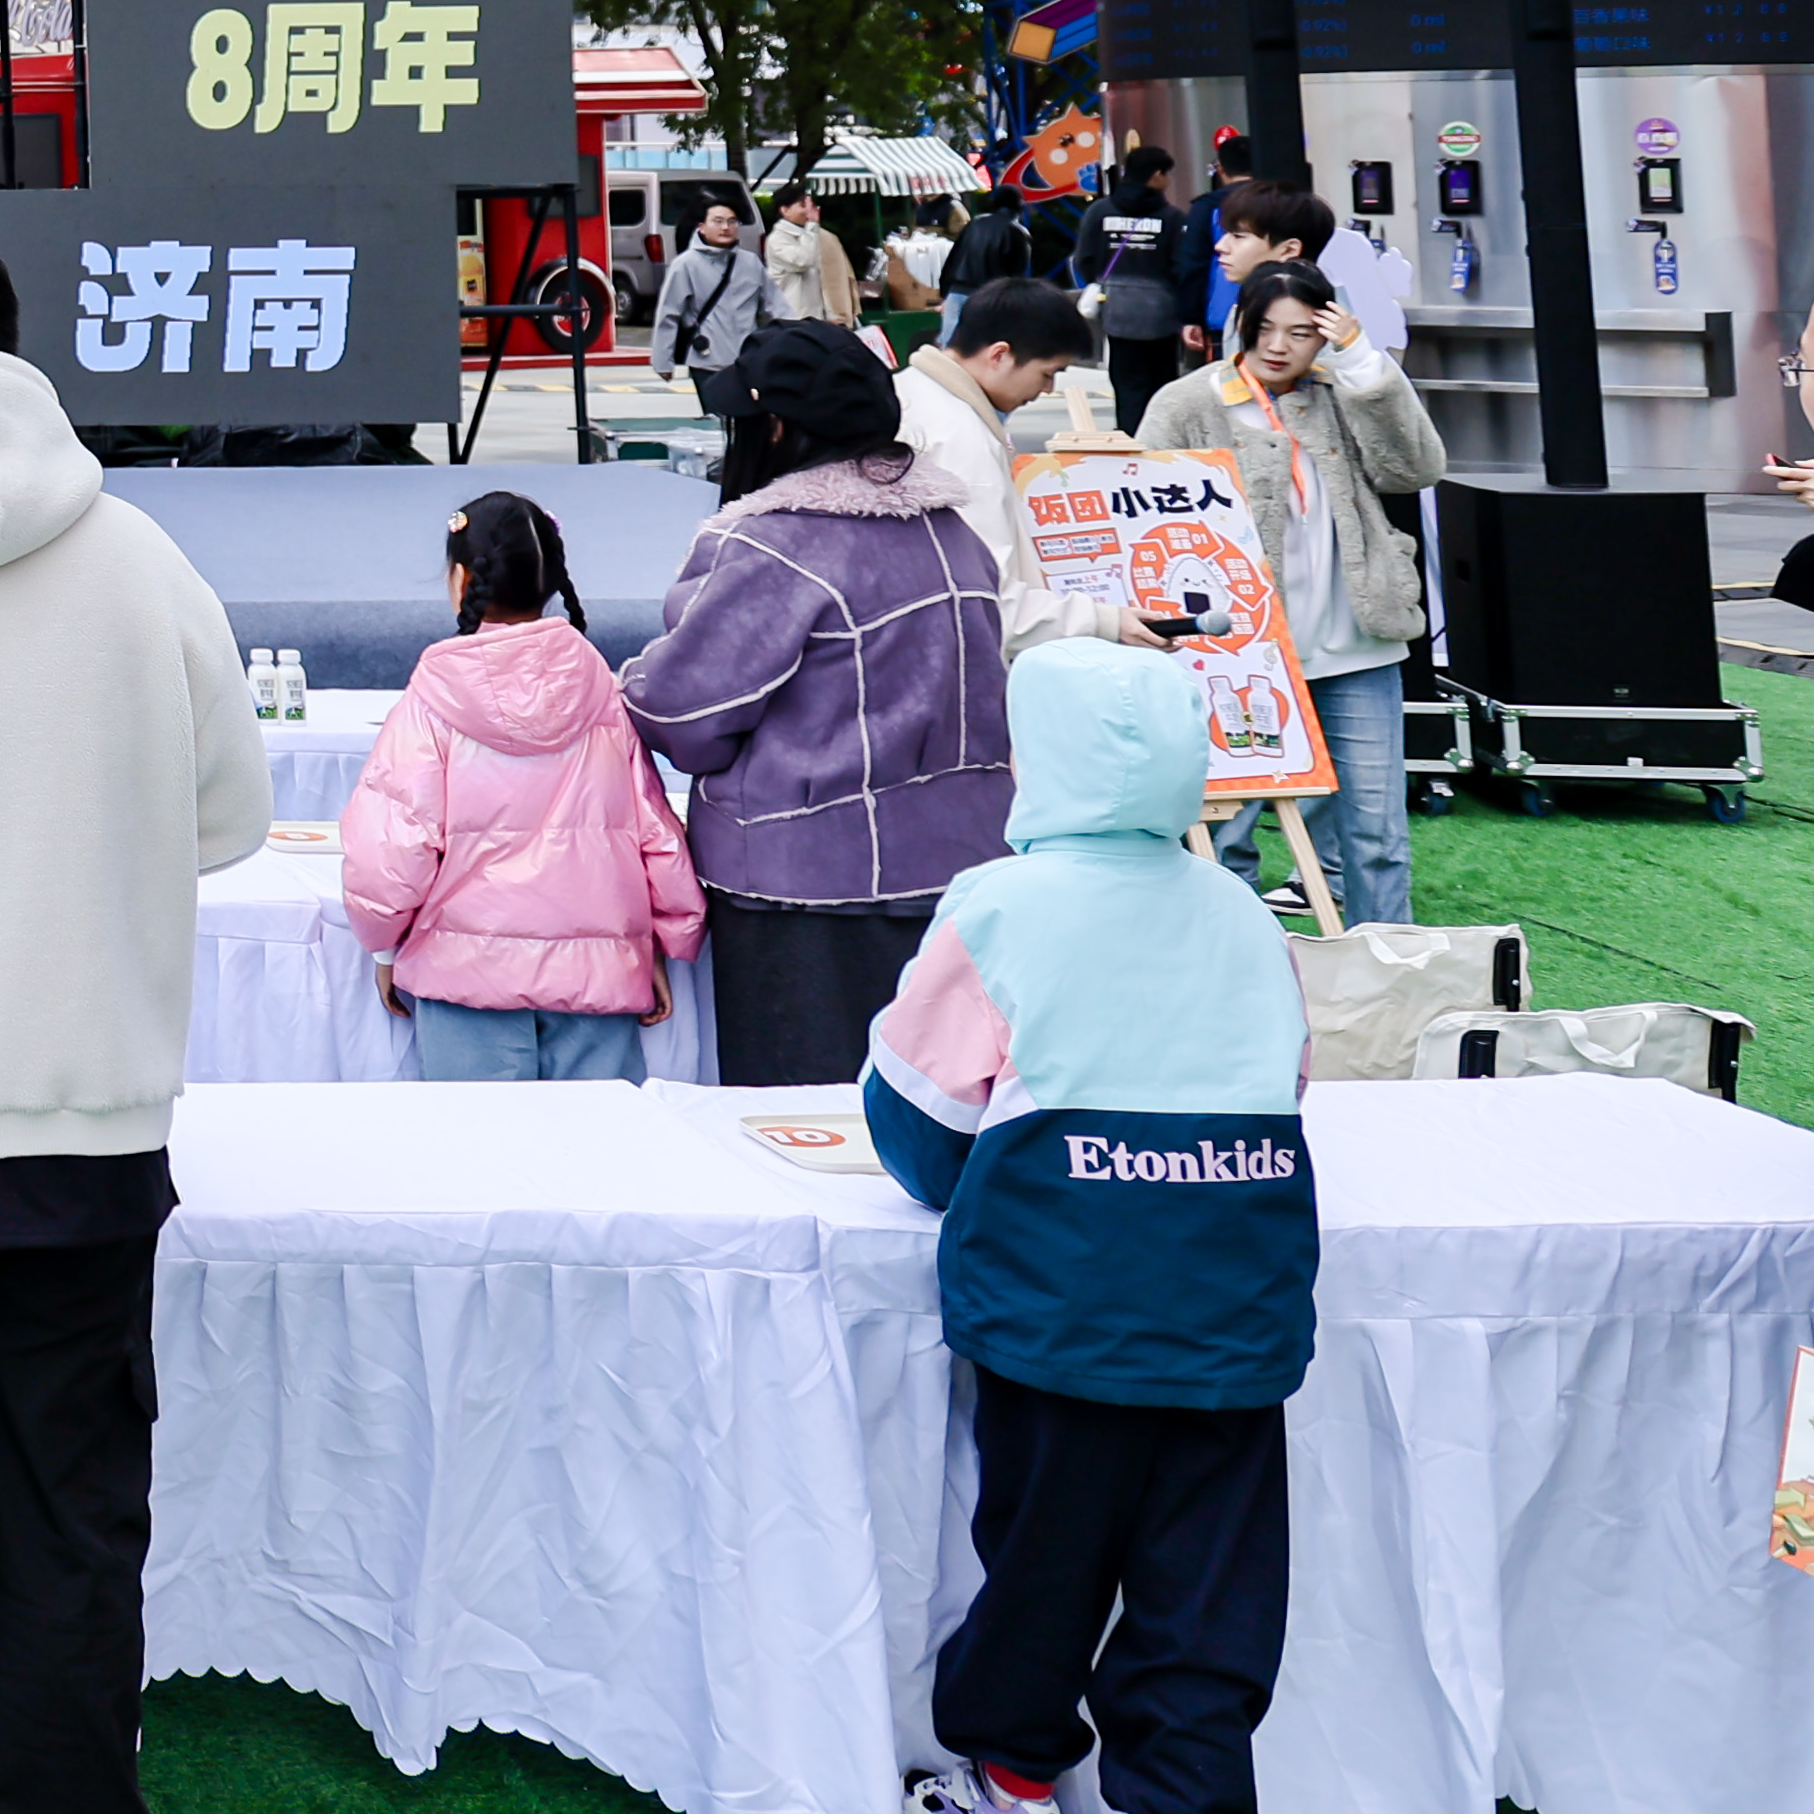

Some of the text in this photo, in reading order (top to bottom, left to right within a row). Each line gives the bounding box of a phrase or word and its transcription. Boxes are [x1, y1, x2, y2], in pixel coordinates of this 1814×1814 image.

[184, 0, 482, 135] 8周年
[72, 238, 358, 375] 济南
[1027, 478, 1235, 528] 饭团小达人
[1191, 532, 1210, 546] 01
[1139, 550, 1158, 563] 05
[1238, 583, 1256, 597] 02
[763, 1129, 832, 1144] 10
[1063, 1132, 1297, 1186] Etonkids
